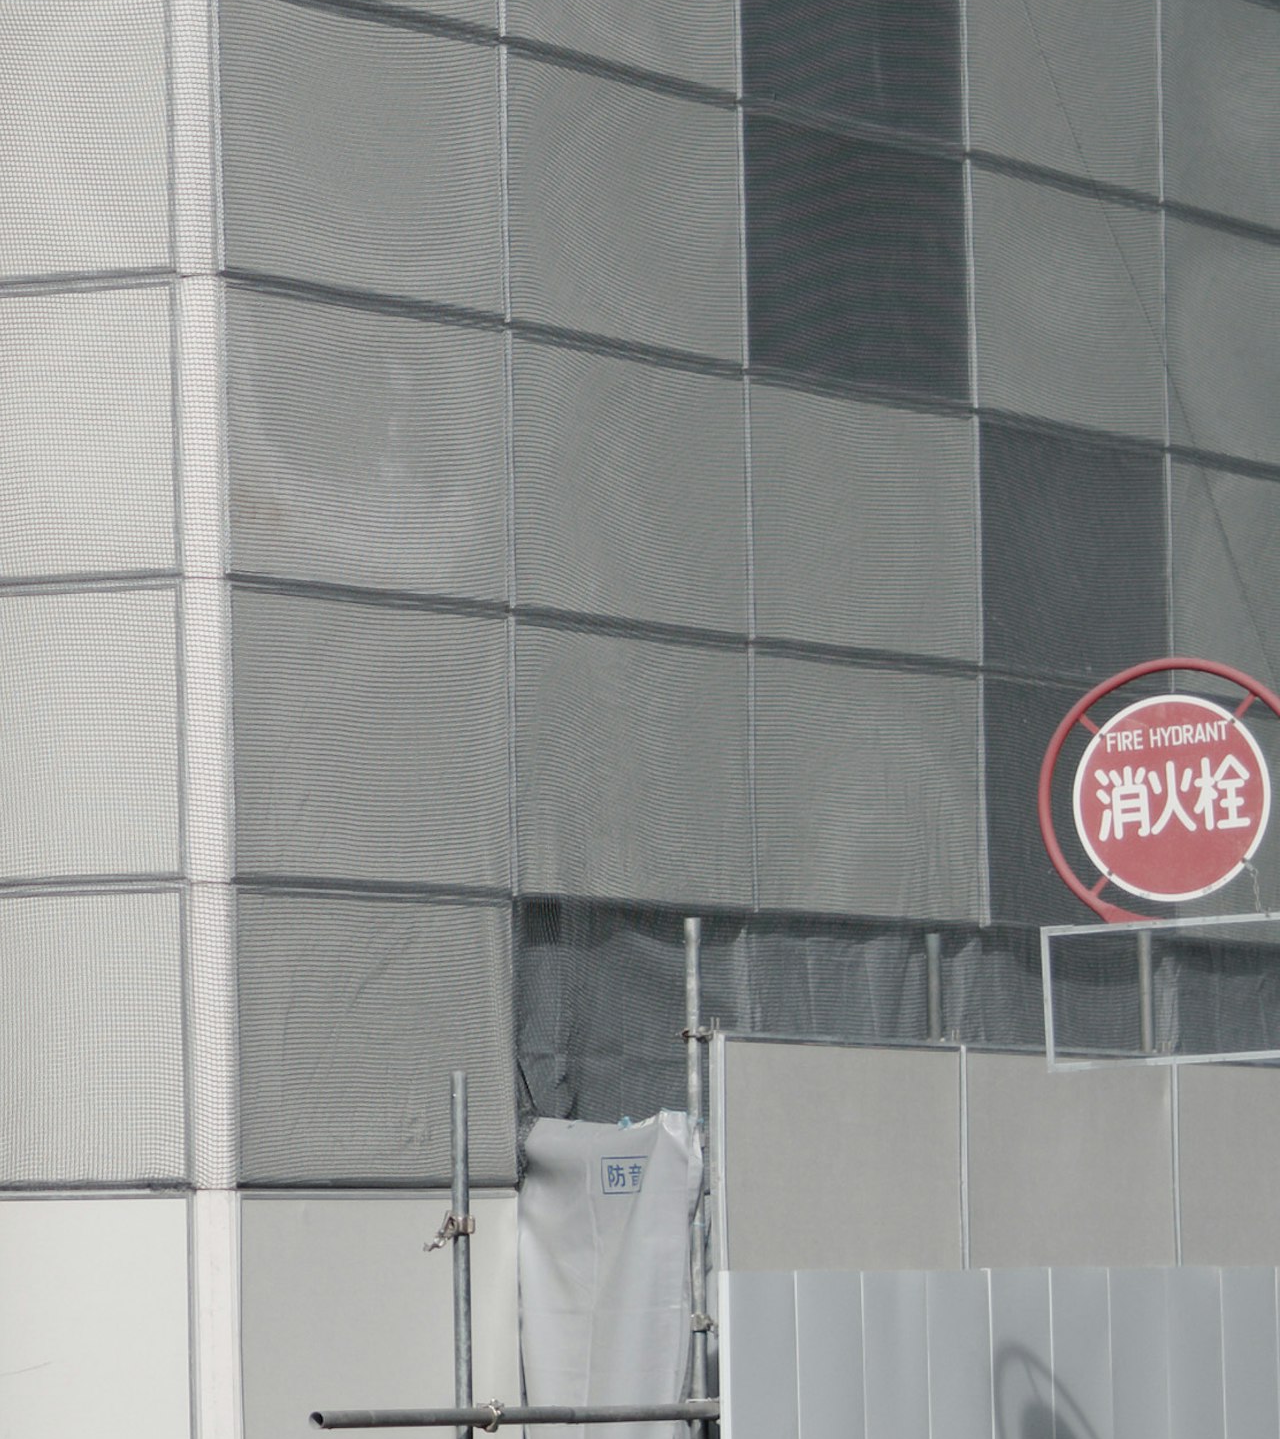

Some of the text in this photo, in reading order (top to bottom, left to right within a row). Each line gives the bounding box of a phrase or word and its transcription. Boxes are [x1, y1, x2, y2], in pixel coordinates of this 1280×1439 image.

[1106, 720, 1228, 754] FIRE HYDRANT
[1094, 754, 1251, 842] 消火栓
